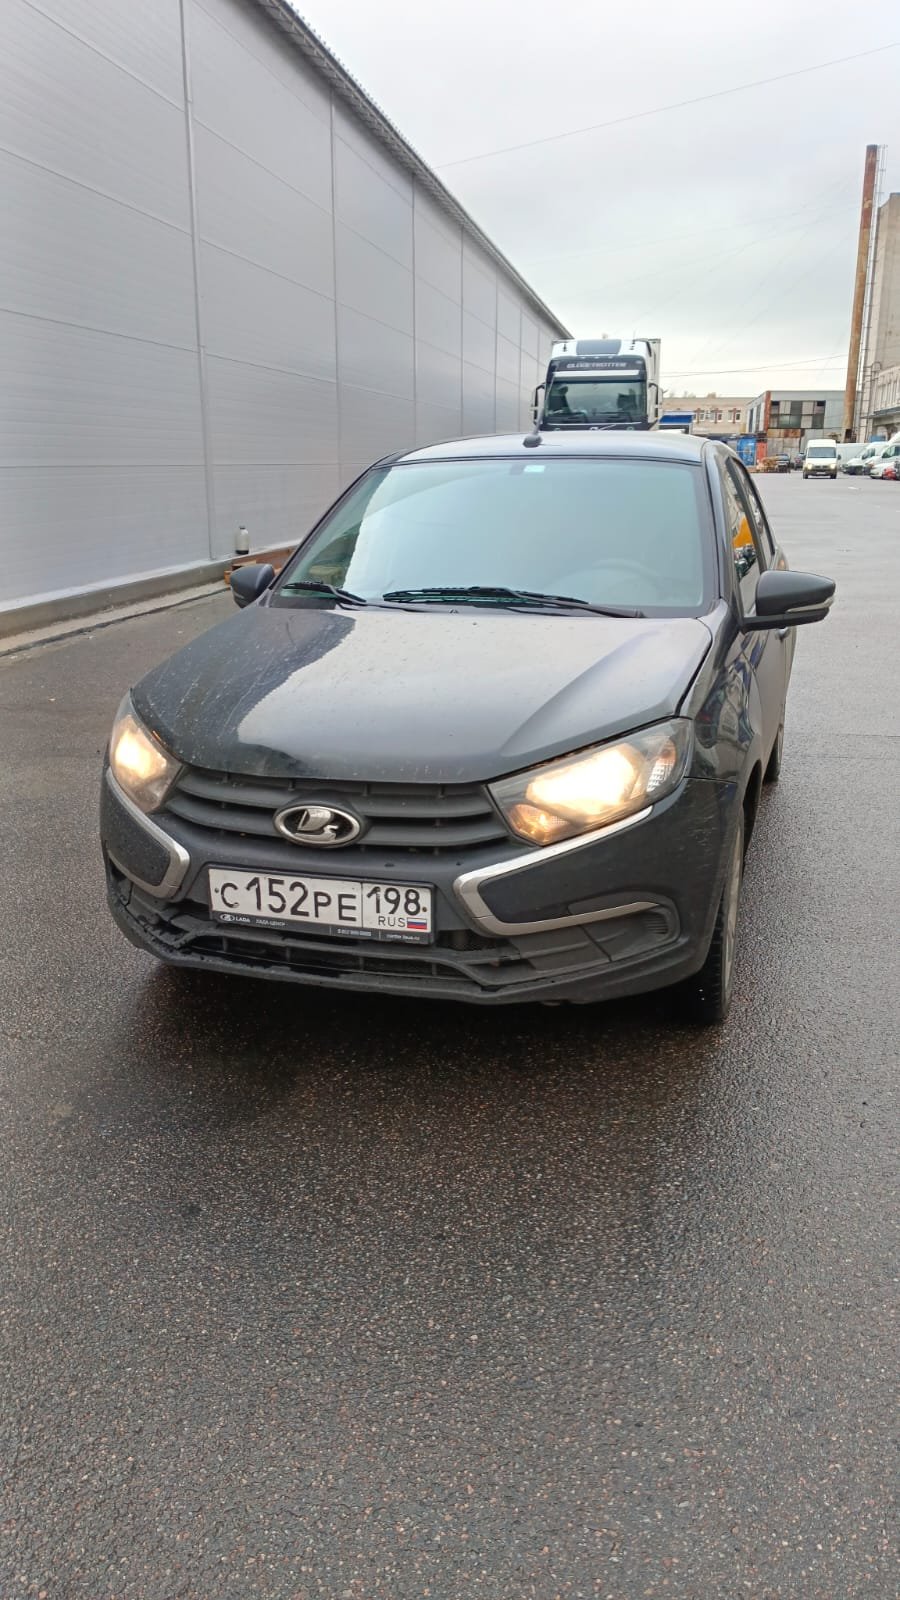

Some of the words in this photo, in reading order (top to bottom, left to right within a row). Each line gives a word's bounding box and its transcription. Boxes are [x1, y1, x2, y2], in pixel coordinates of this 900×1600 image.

[220, 877, 357, 922] С152РЕ
[366, 886, 421, 916] 198
[378, 916, 406, 928] RUS
